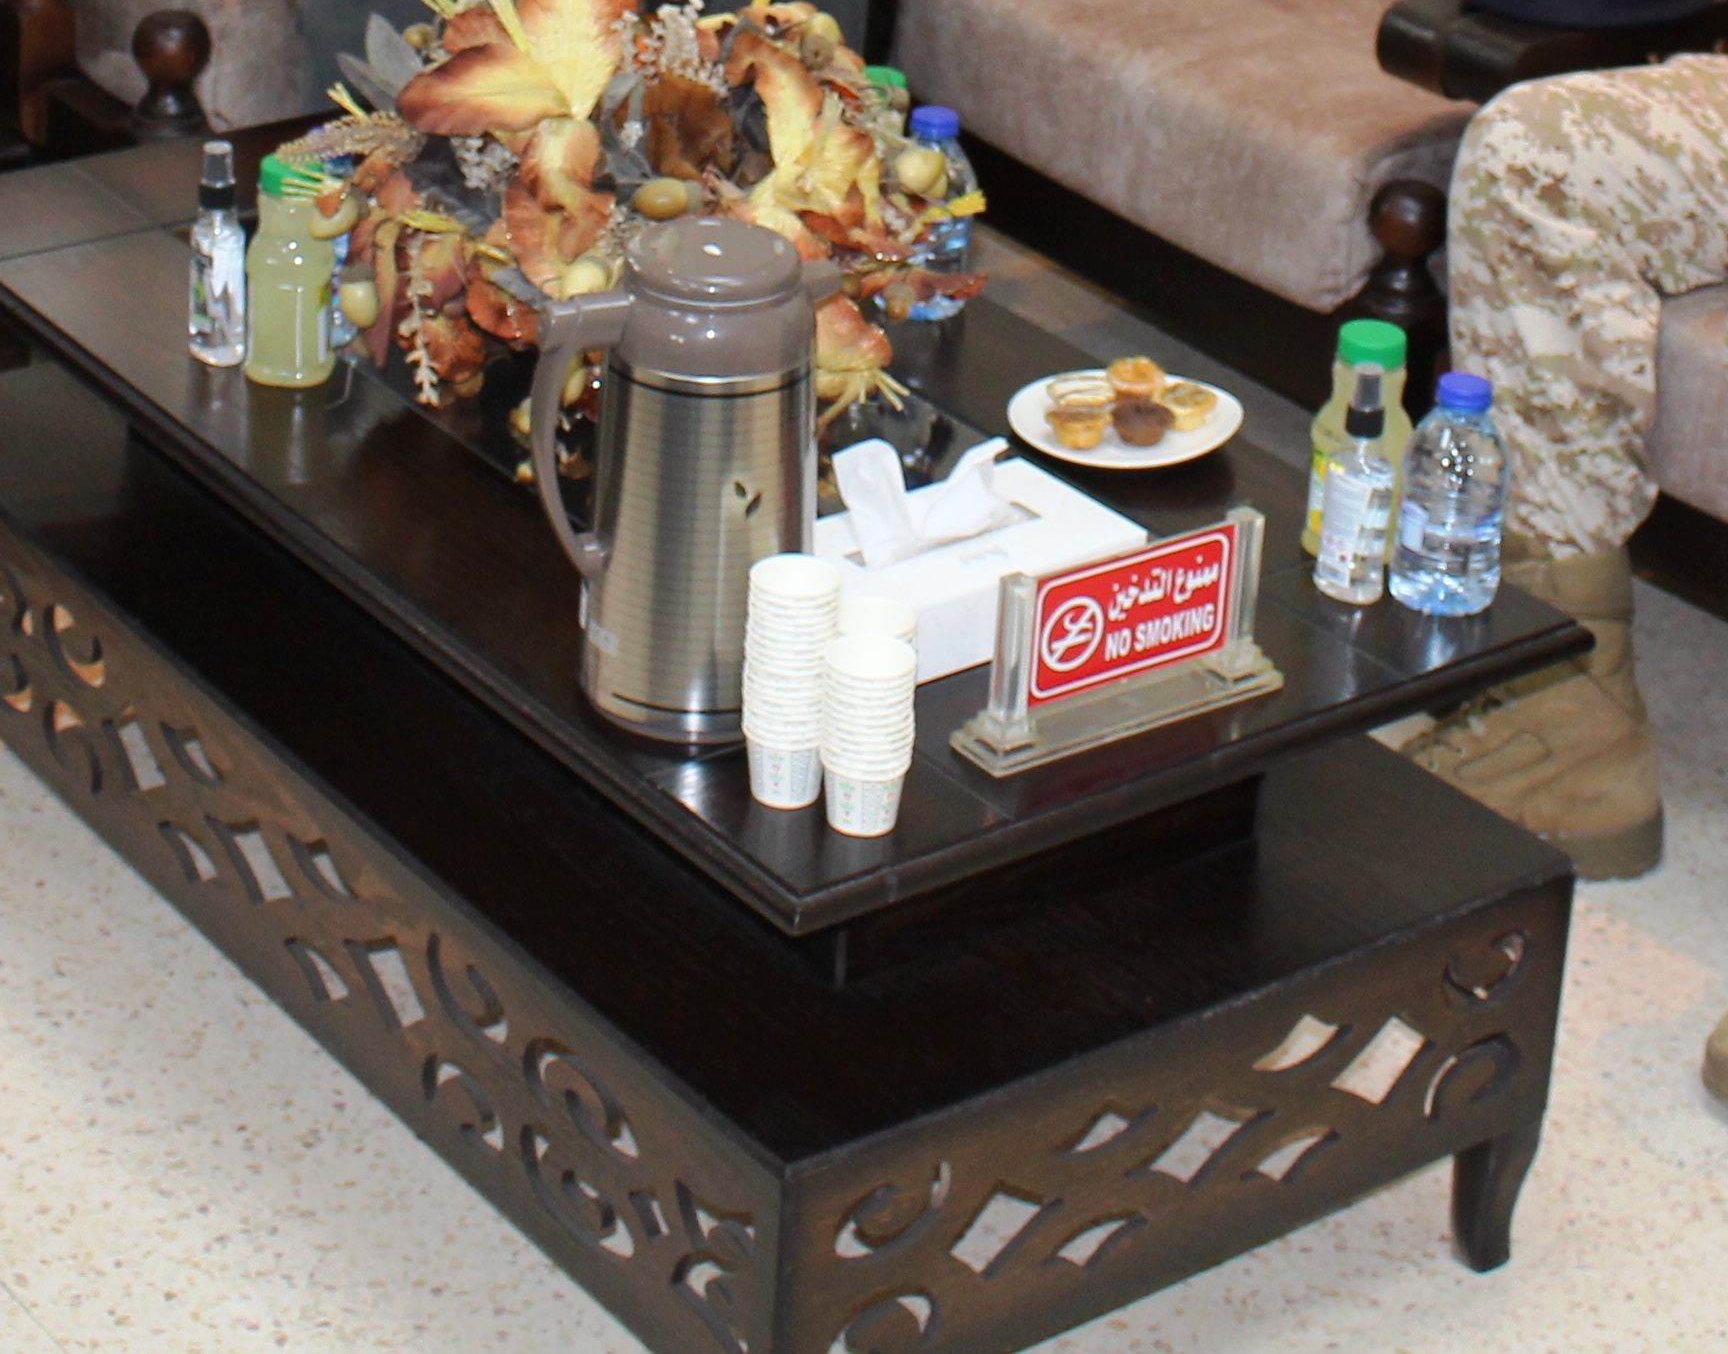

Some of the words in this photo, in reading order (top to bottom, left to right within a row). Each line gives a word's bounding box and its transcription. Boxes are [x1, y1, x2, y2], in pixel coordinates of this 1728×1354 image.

[1108, 567, 1172, 621] التدخين
[1173, 555, 1220, 604] ممنوع
[1104, 628, 1132, 661] NO
[1134, 603, 1215, 652] SMOKING
